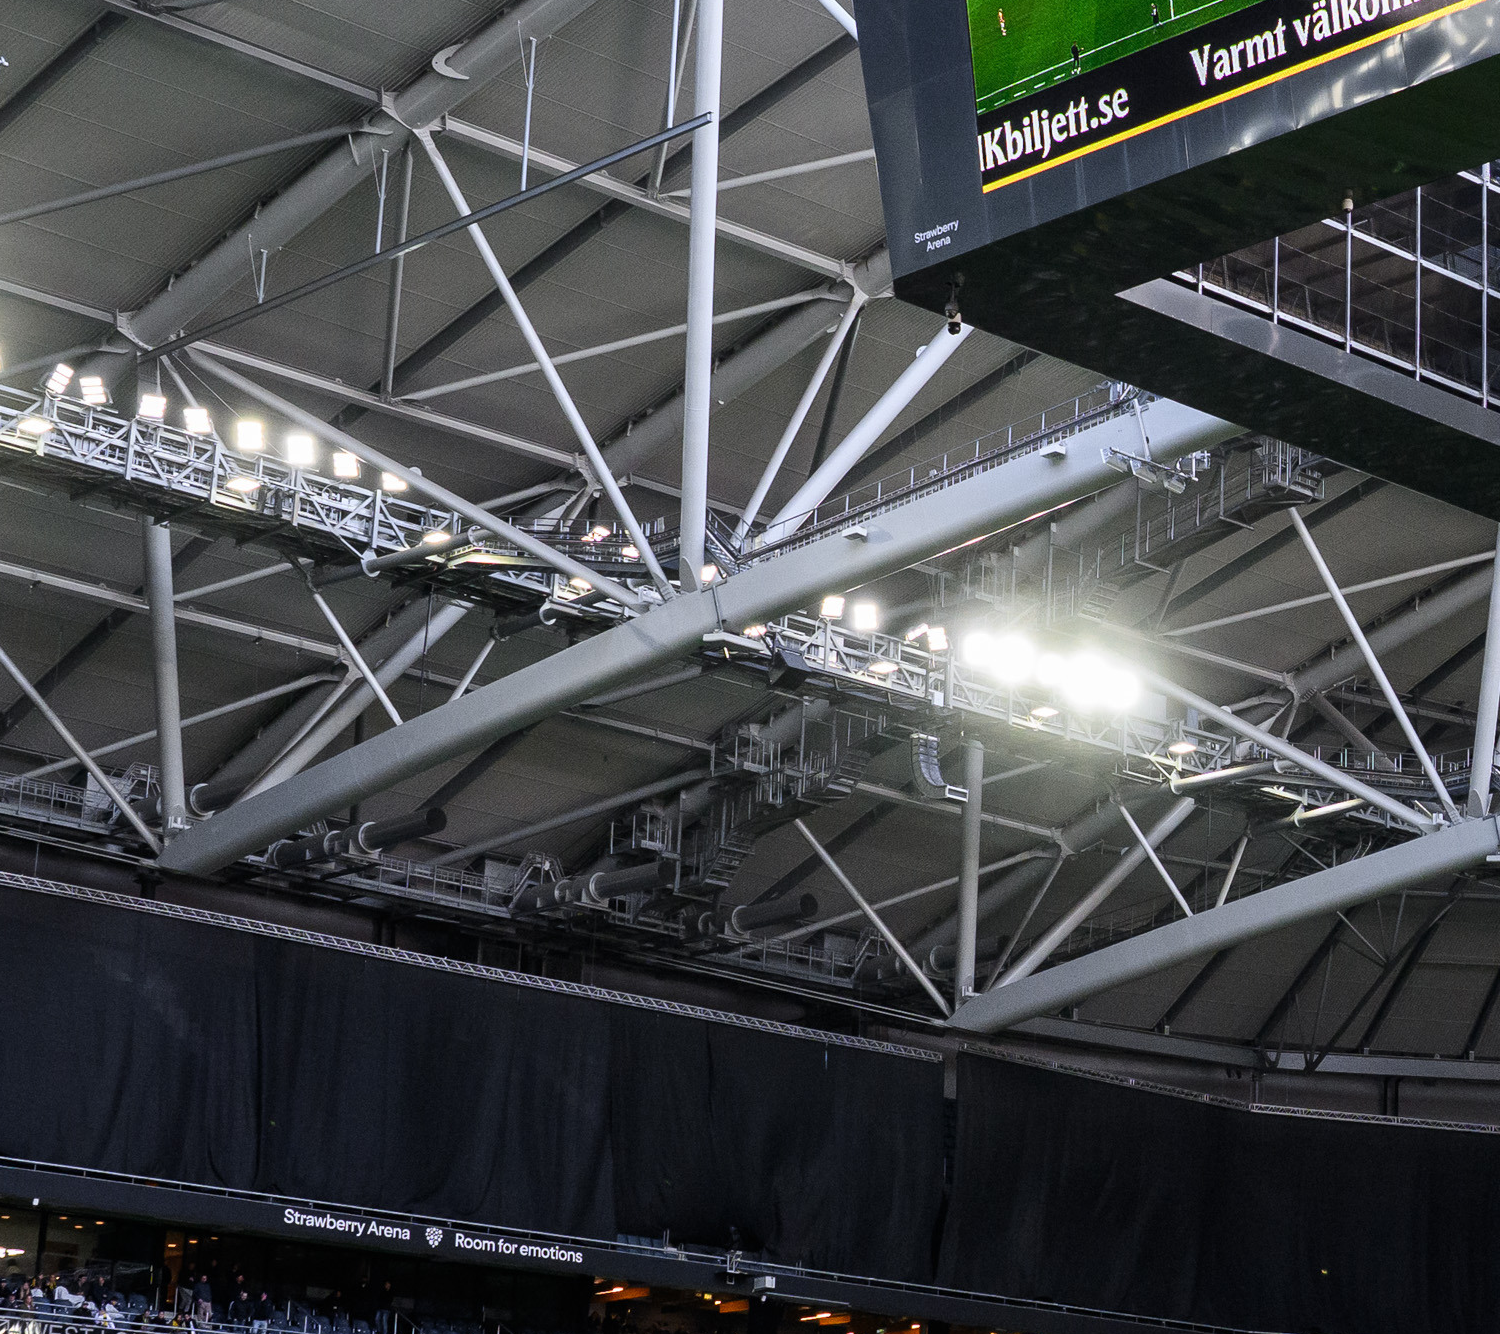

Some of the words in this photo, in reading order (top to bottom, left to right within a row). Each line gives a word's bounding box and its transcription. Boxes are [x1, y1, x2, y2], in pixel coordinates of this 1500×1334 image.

[1189, 24, 1288, 87] Varmt
[914, 219, 959, 244] Strawberry
[926, 235, 952, 253] Arena
[284, 1208, 366, 1238] Strawberry
[367, 1220, 412, 1241] Arena
[455, 1233, 496, 1253] Room
[496, 1238, 519, 1255] for
[519, 1241, 584, 1265] emotions
